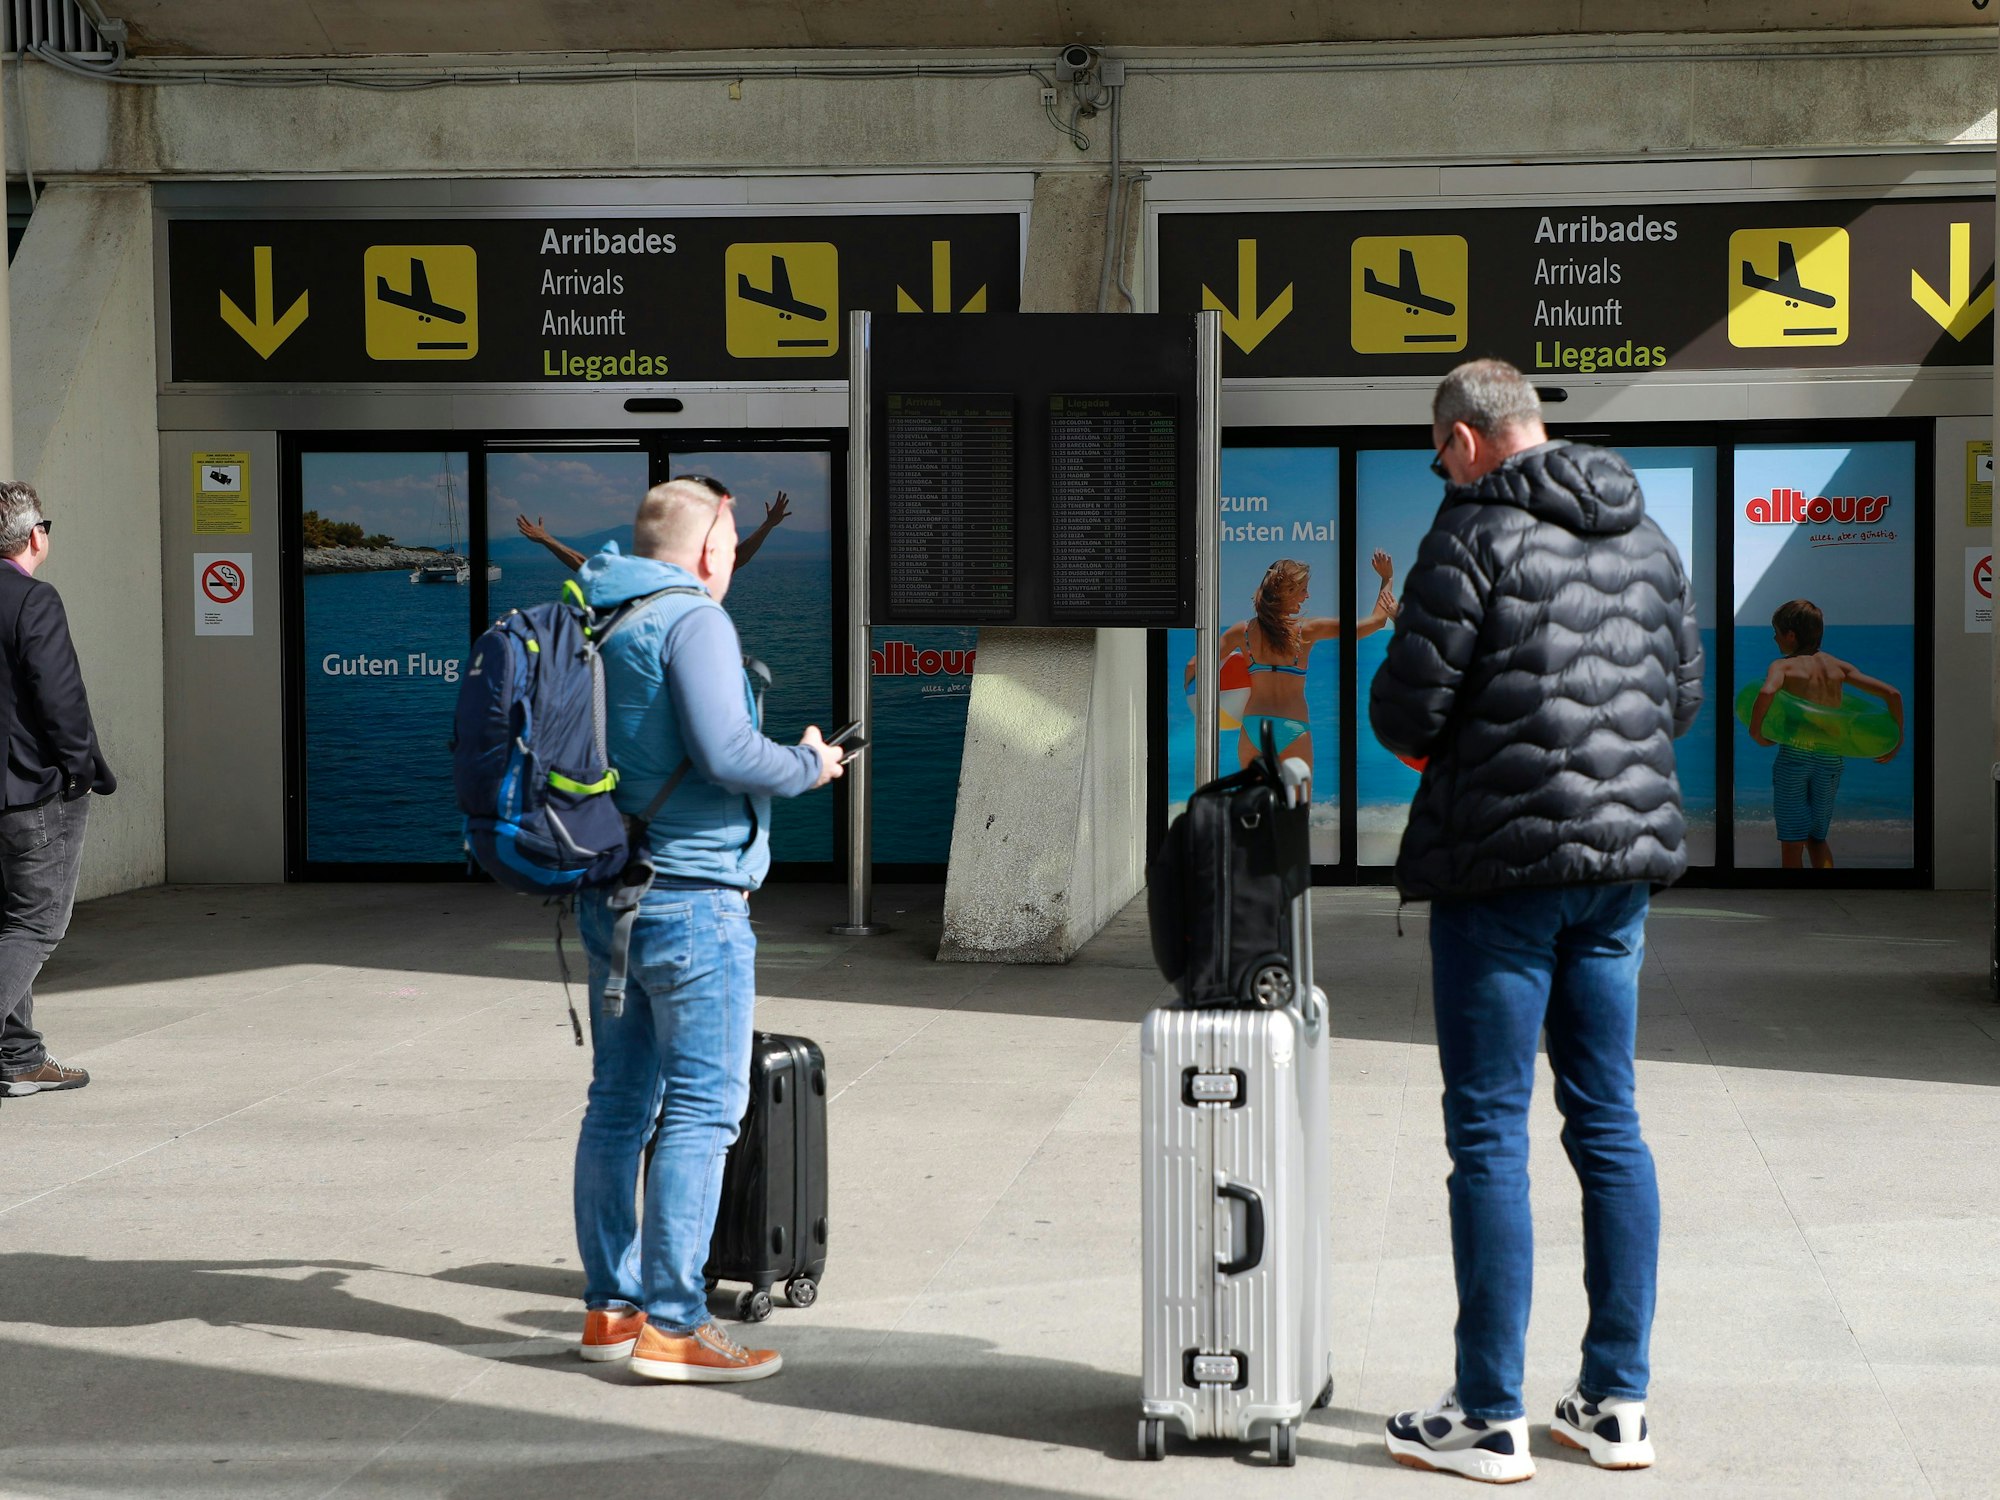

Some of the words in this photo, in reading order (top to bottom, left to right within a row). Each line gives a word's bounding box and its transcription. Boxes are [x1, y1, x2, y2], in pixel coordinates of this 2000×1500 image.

[540, 227, 677, 255] Arribades
[1534, 214, 1678, 243] Arribades
[541, 268, 624, 295] Arrivals
[1534, 257, 1622, 285] Arrivals
[541, 308, 626, 336] Ankunft
[1534, 298, 1623, 327] Ankunft
[543, 350, 669, 380] Llegadas
[1535, 340, 1667, 374] Llegadas
[1067, 400, 1110, 409] Llegadas
[1219, 496, 1268, 512] zum
[1745, 487, 1890, 525] alltours
[1219, 519, 1284, 542] hsten
[1291, 519, 1335, 542] Mal
[1837, 532, 1857, 541] aber
[322, 653, 398, 676] Guten
[408, 652, 459, 682] Flug
[947, 683, 965, 692] aber
